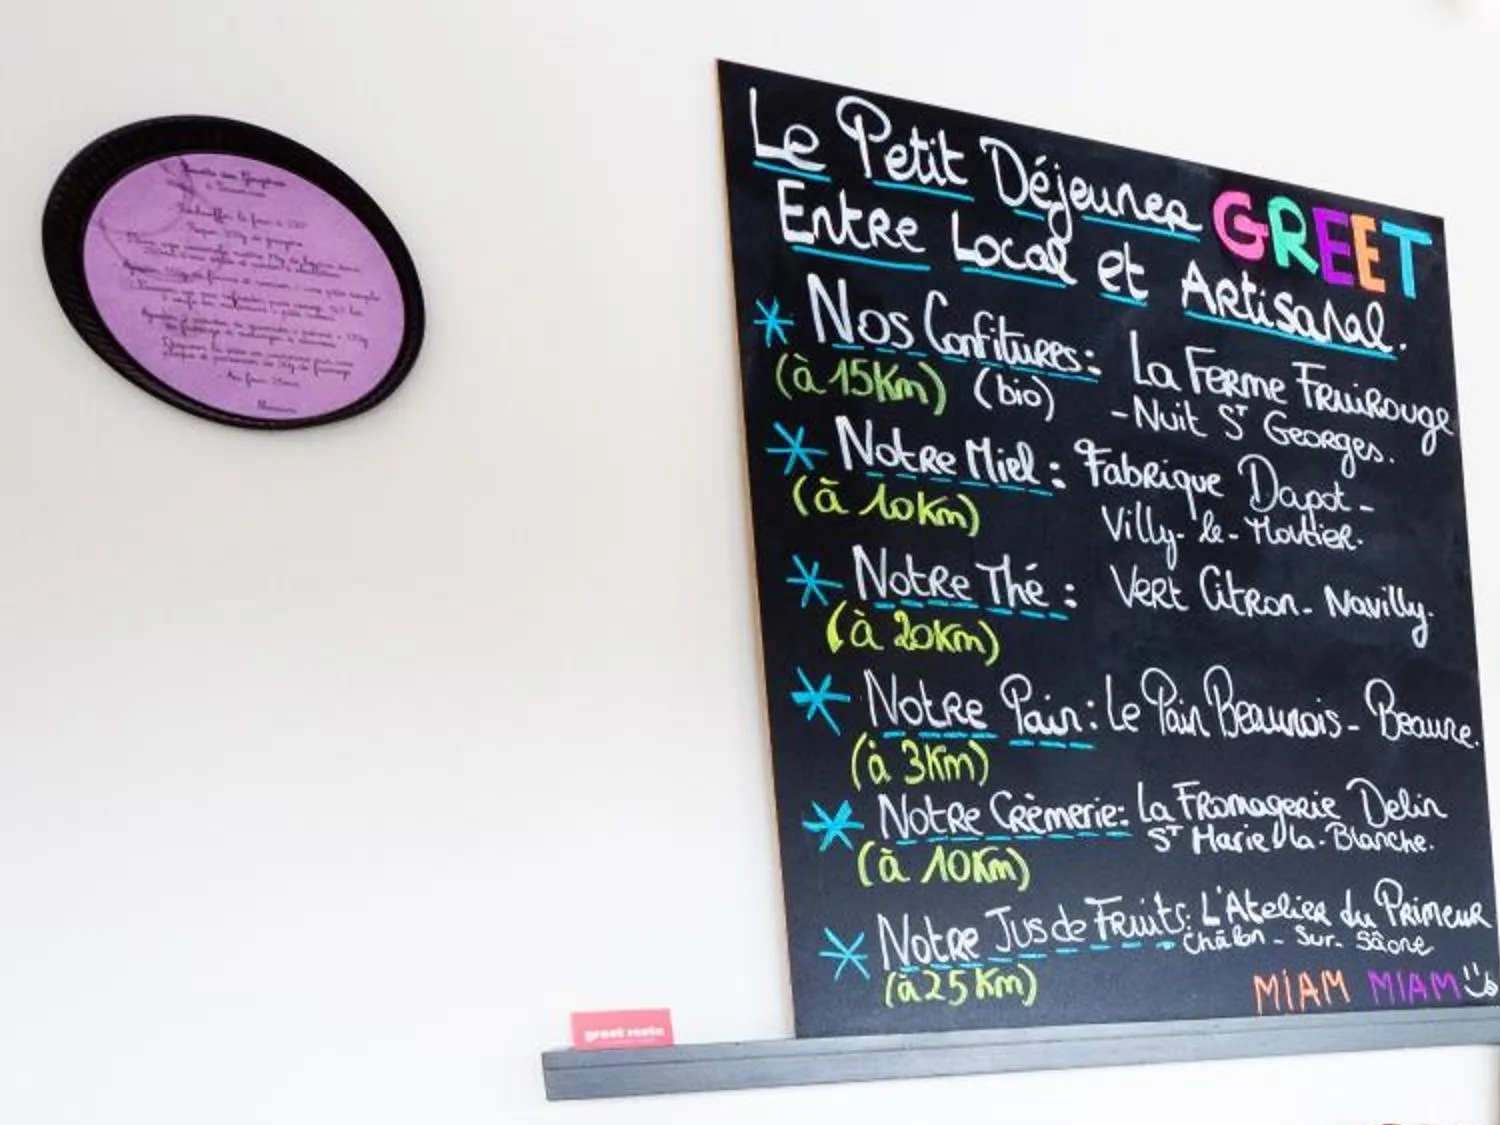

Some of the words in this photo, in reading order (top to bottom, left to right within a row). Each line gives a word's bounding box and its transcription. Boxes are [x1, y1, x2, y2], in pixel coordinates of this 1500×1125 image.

[750, 87, 826, 171] Le
[836, 96, 968, 186] Petit
[979, 136, 1202, 244] Déjeuner
[1213, 190, 1432, 299] GREET
[777, 179, 926, 252] Entre
[952, 210, 1078, 285] Local
[1098, 242, 1148, 299] et
[807, 273, 914, 350] Nos
[974, 367, 1054, 422] (bio)
[1130, 330, 1182, 392] La
[1185, 346, 1287, 405] Ferme
[835, 415, 956, 476] Notre
[1074, 438, 1224, 521] Fabrique
[852, 544, 973, 601] Notre
[1109, 564, 1189, 611] Vert
[864, 668, 989, 730] Notre
[1141, 667, 1211, 737] Pain
[877, 793, 984, 840] Notre
[1137, 781, 1176, 824] La
[1171, 781, 1341, 849] Fromagerie
[1345, 777, 1448, 829] Delin
[1192, 823, 1270, 854] Marie
[878, 912, 980, 971] Notre
[984, 905, 1049, 952] Jus
[1051, 904, 1087, 942] de
[1201, 885, 1331, 927] L'Atelier
[1340, 889, 1377, 930] du
[1374, 878, 1492, 929] Primeur
[1253, 968, 1351, 1016] MIAM
[1367, 970, 1461, 1005] MIAM
